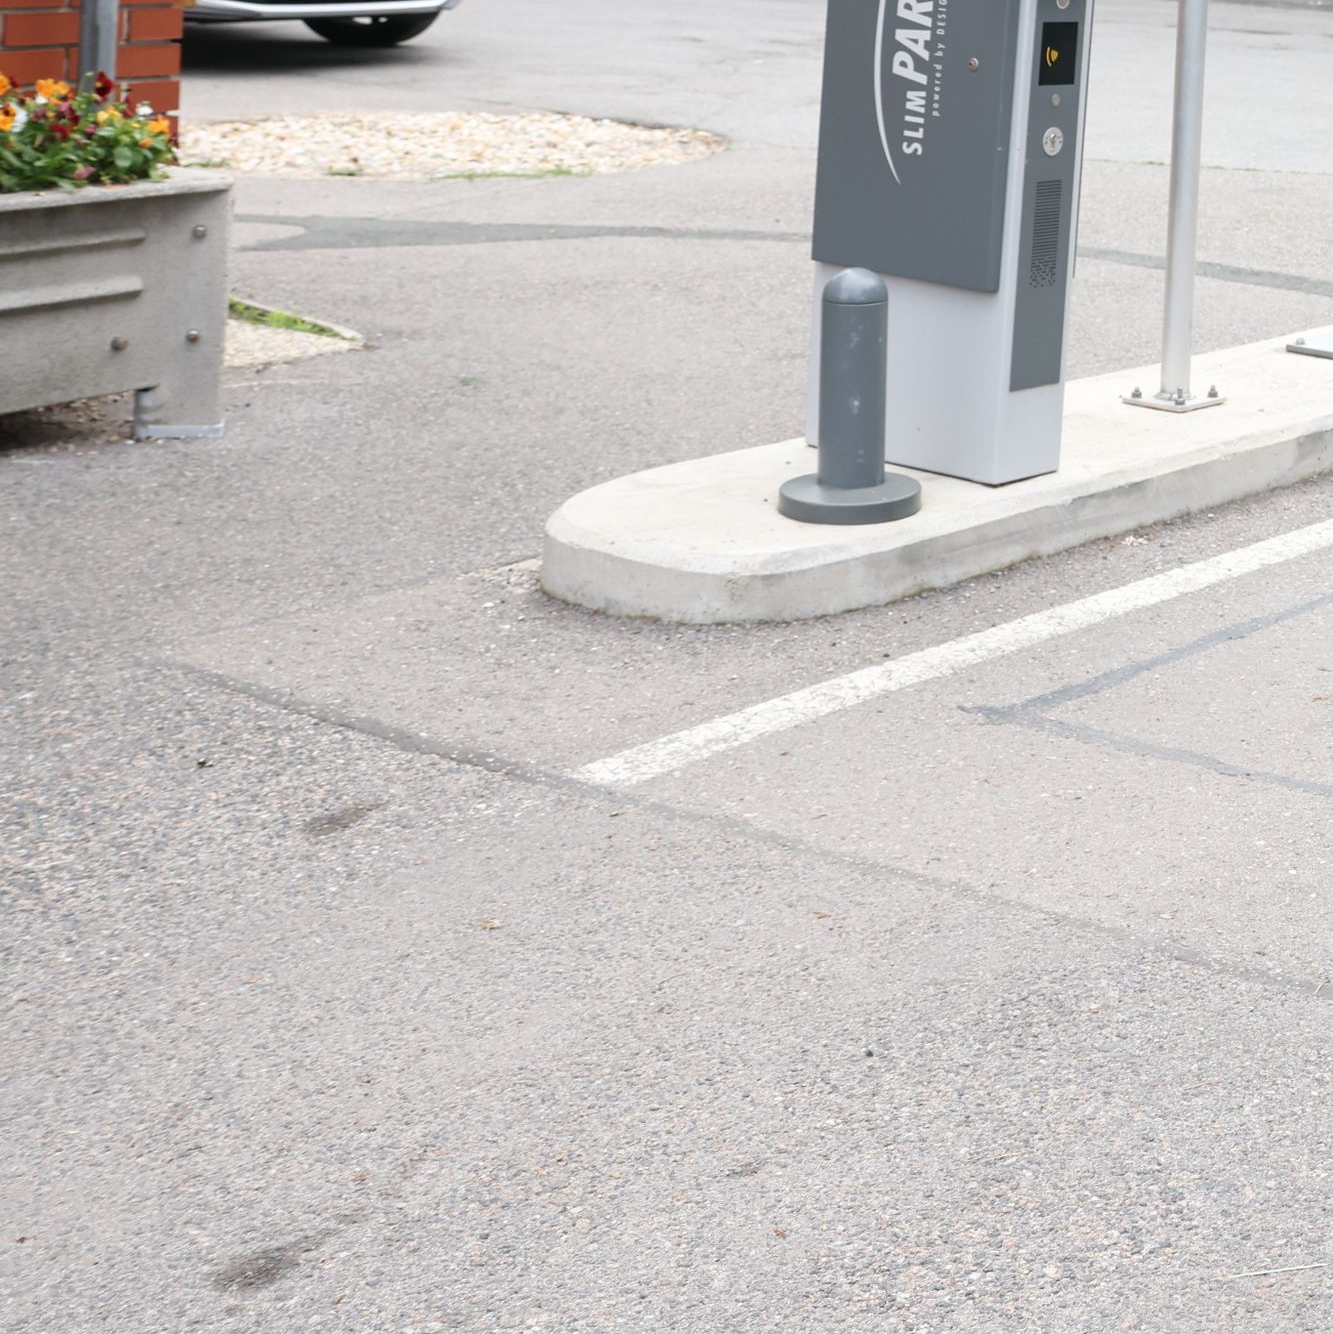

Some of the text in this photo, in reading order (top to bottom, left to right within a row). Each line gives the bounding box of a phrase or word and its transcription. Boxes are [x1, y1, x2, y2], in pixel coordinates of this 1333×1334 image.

[934, 43, 946, 57] by
[931, 64, 942, 117] powered
[902, 90, 927, 156] SLIM
